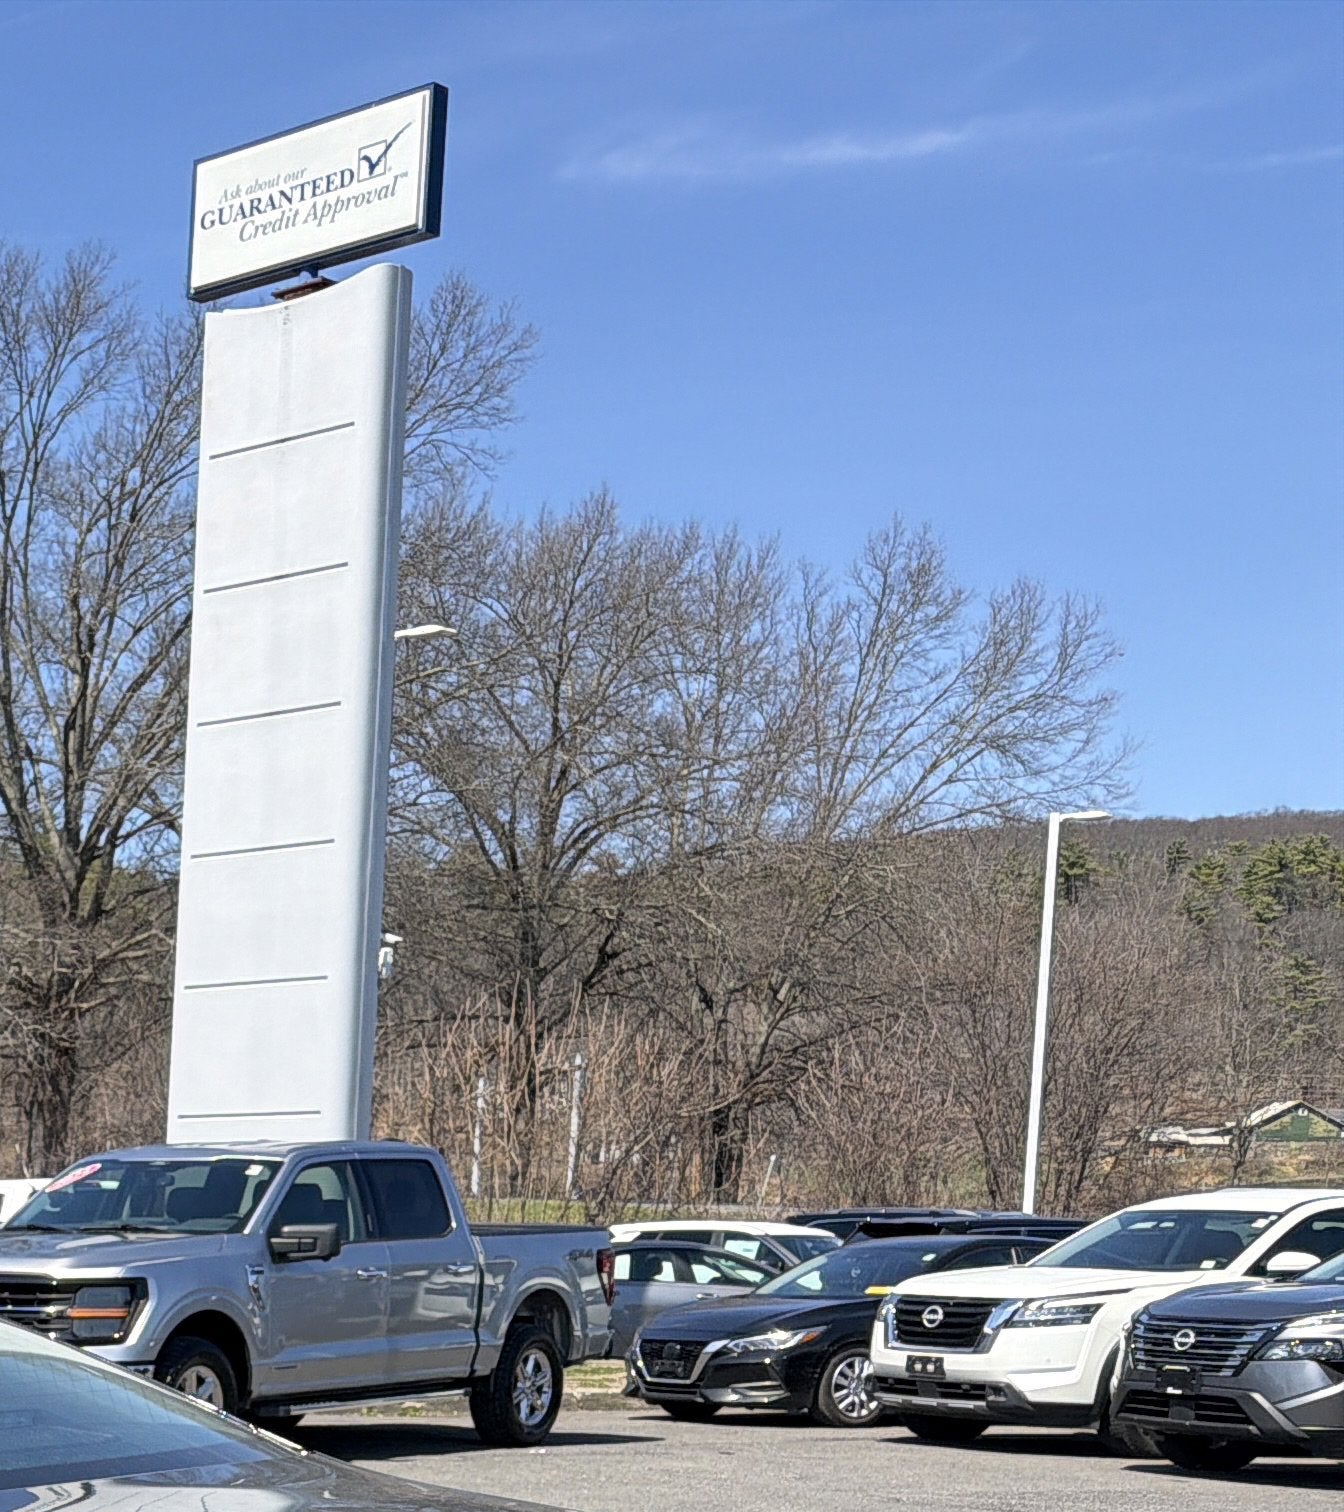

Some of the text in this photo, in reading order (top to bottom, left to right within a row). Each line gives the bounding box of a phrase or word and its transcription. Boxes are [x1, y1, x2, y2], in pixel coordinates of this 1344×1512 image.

[200, 168, 355, 230] GUARANTEED
[218, 167, 307, 204] Ask about our
[239, 207, 300, 242] Credit
